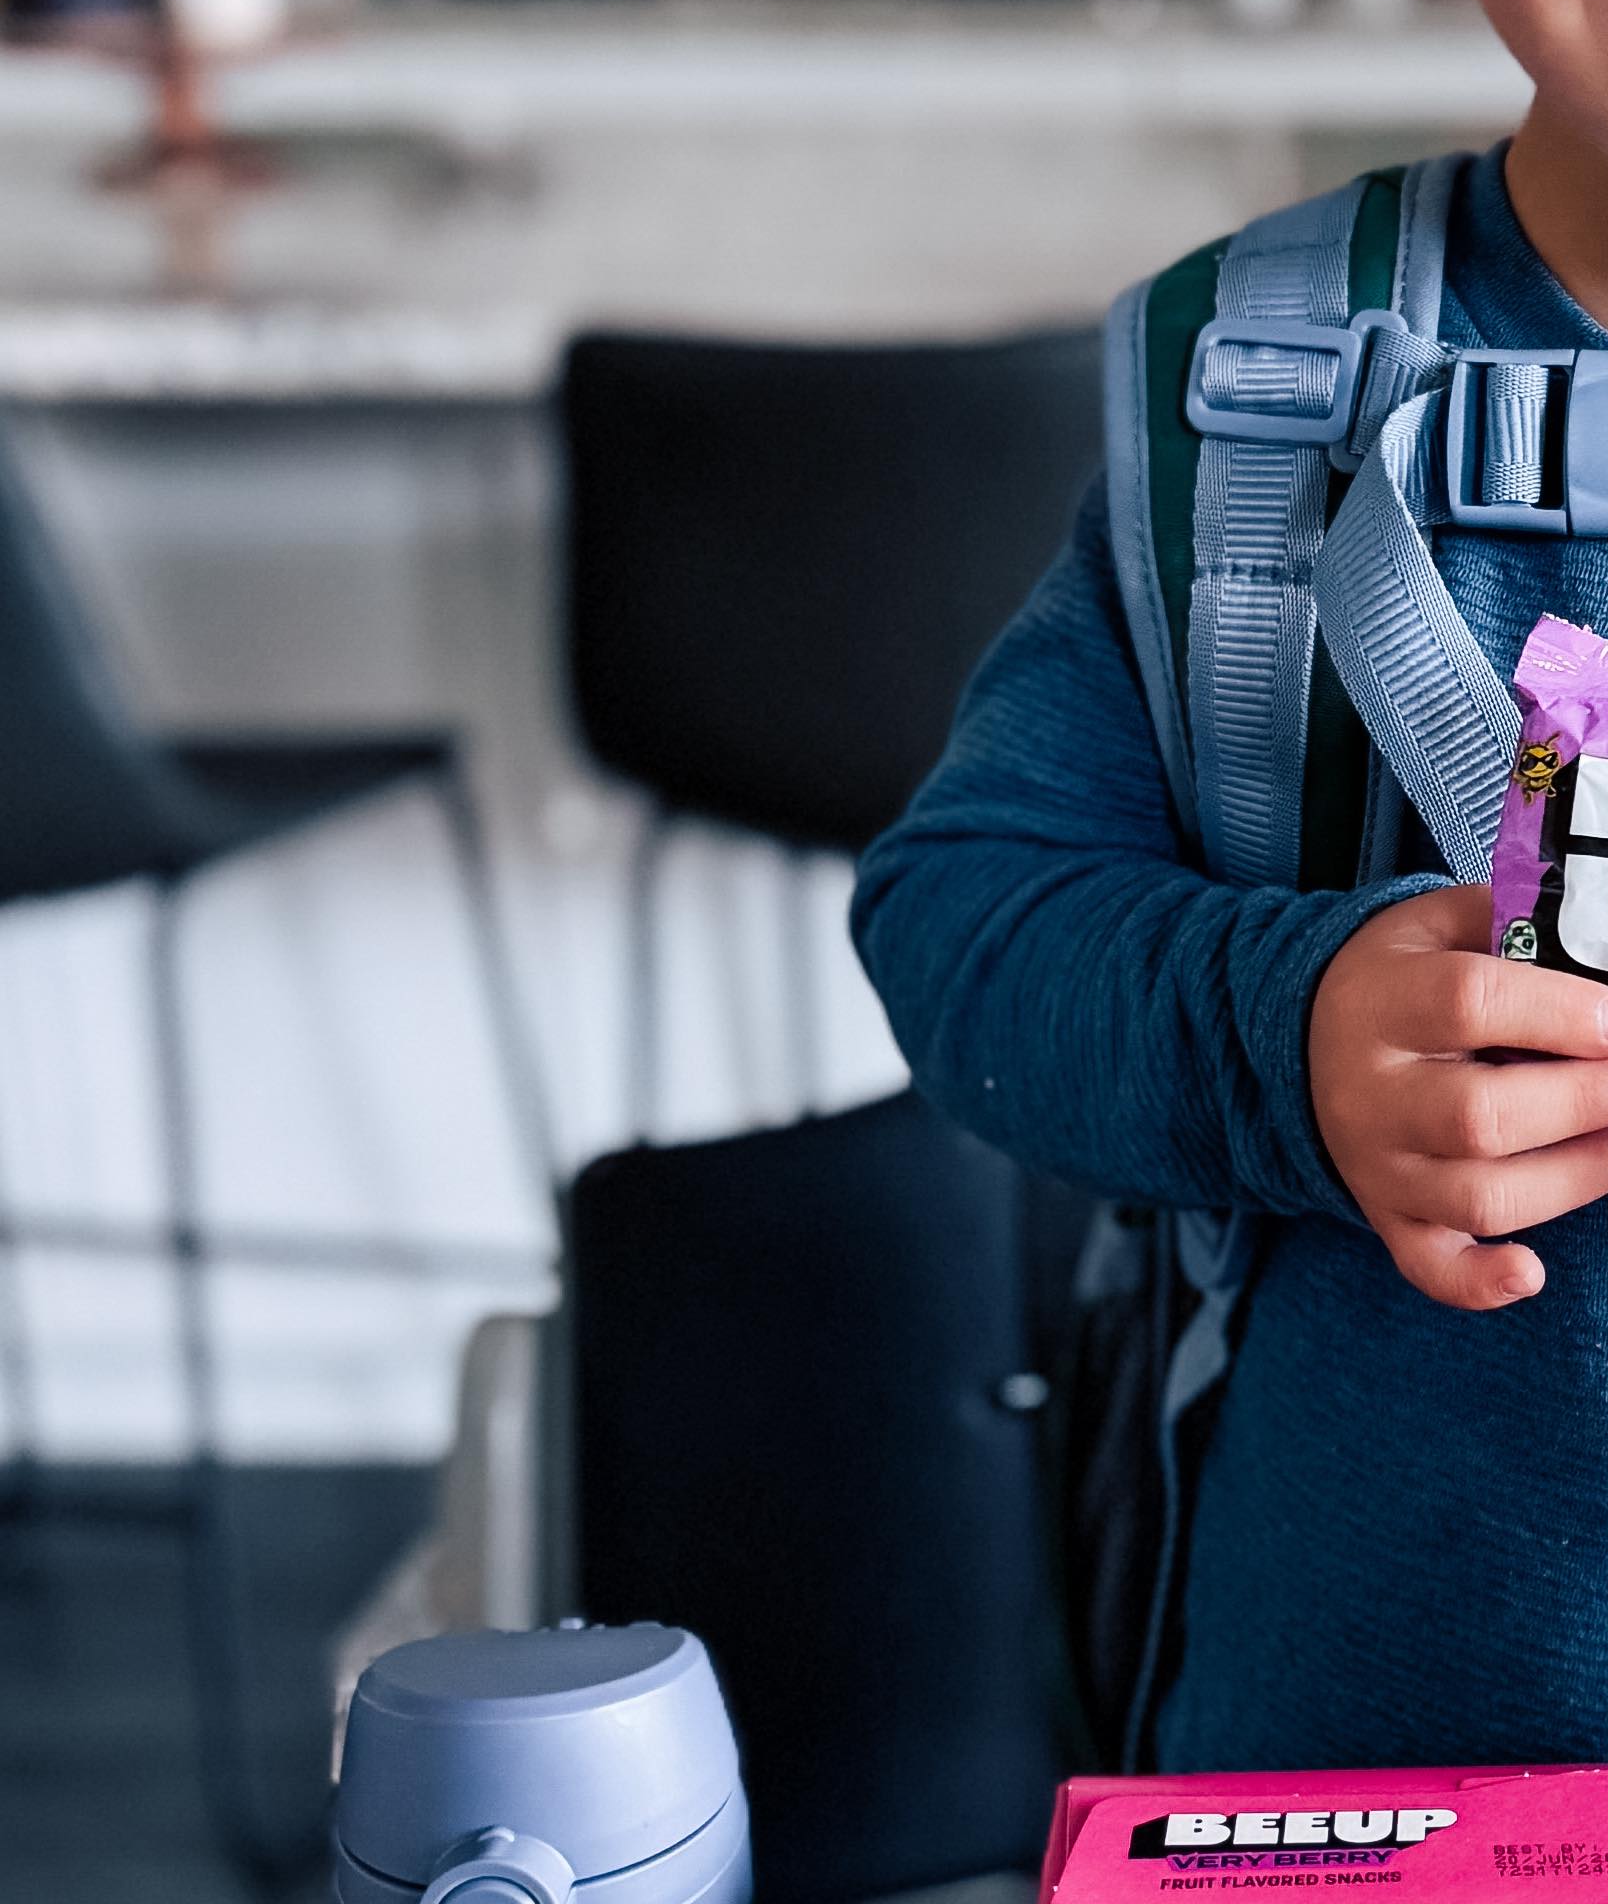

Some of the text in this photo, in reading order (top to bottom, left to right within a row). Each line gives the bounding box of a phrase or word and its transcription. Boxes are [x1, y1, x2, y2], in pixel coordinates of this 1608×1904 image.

[1165, 1809, 1458, 1846] BEEUP
[1493, 1844, 1545, 1855] BEST
[1172, 1850, 1396, 1870] VERY BERRY
[1160, 1871, 1402, 1890] FRUIT FLAVORED SNACKS
